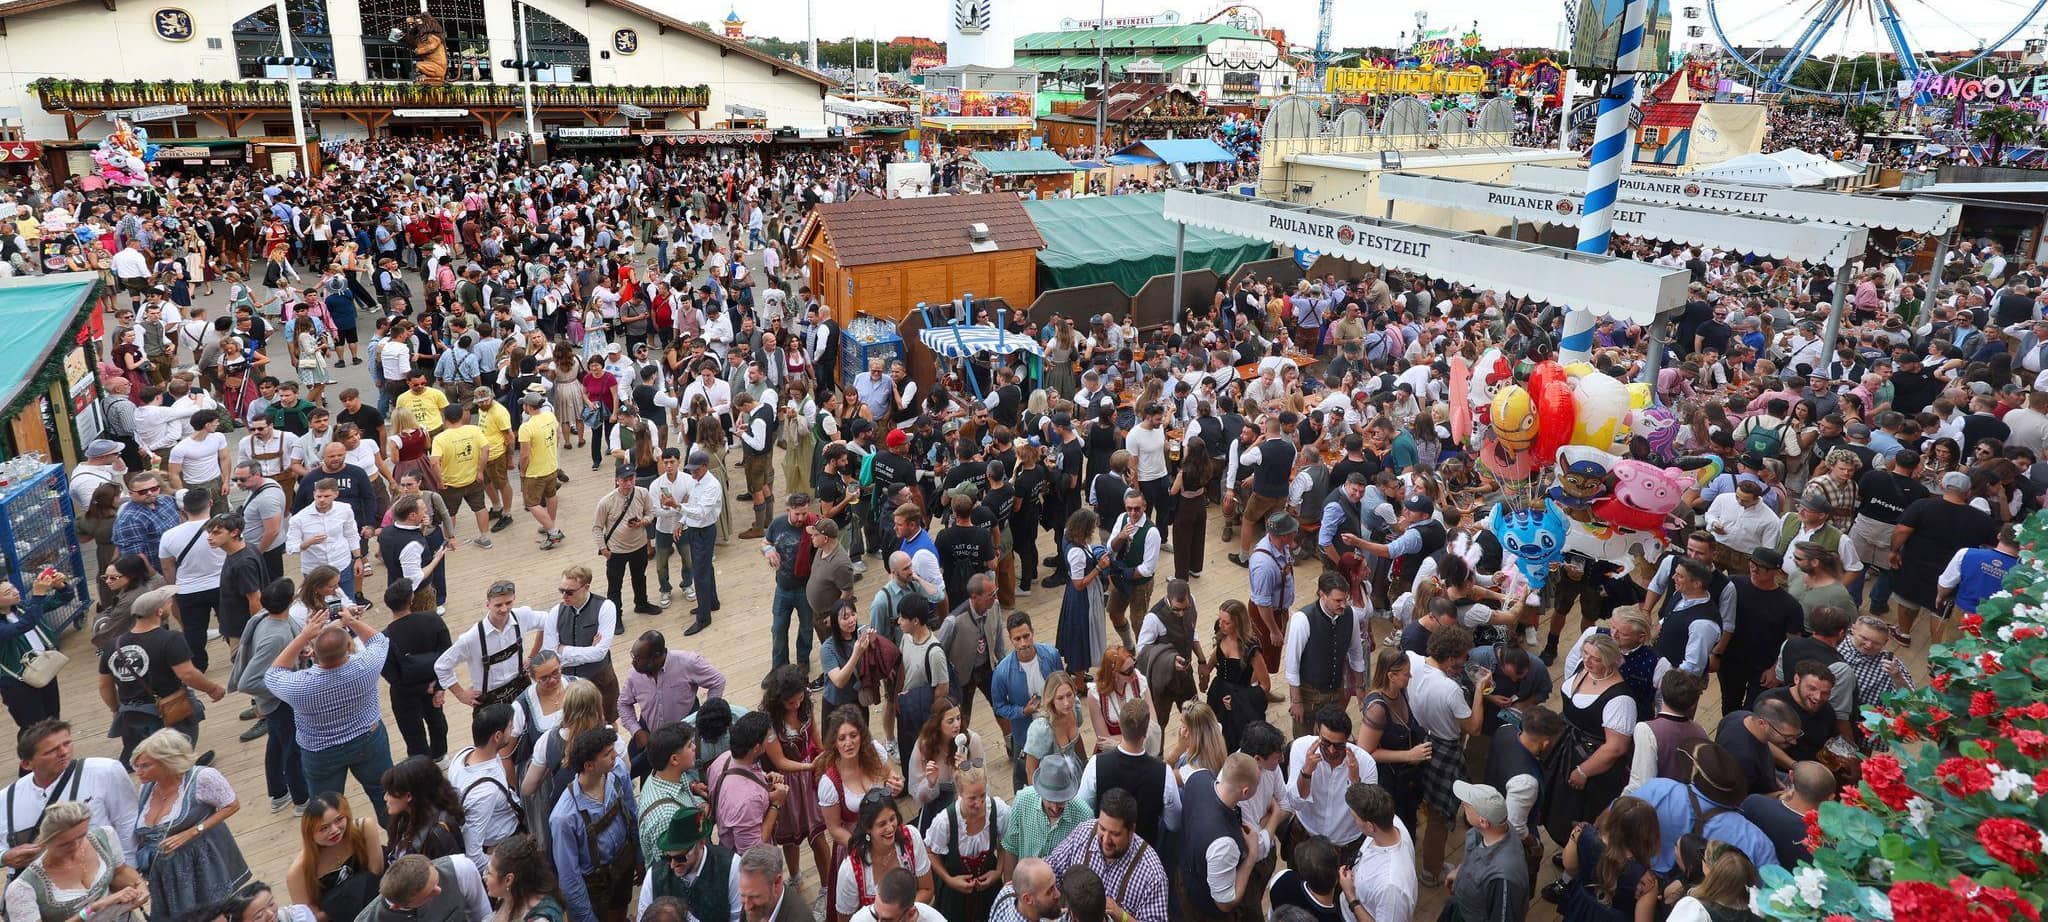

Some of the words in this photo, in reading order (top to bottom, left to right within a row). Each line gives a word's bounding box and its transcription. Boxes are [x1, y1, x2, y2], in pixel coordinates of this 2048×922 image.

[1079, 20, 1113, 28] KUFRS
[1116, 17, 1154, 26] WEINZELT
[1572, 105, 1590, 127] AUF
[1618, 179, 1681, 195] PAULANER
[1702, 187, 1768, 203] FESTZELT
[1488, 192, 1553, 211] PAULANER
[1577, 203, 1647, 224] FZELT
[1269, 214, 1335, 239] PAULANER
[1358, 231, 1431, 258] FESTZELT
